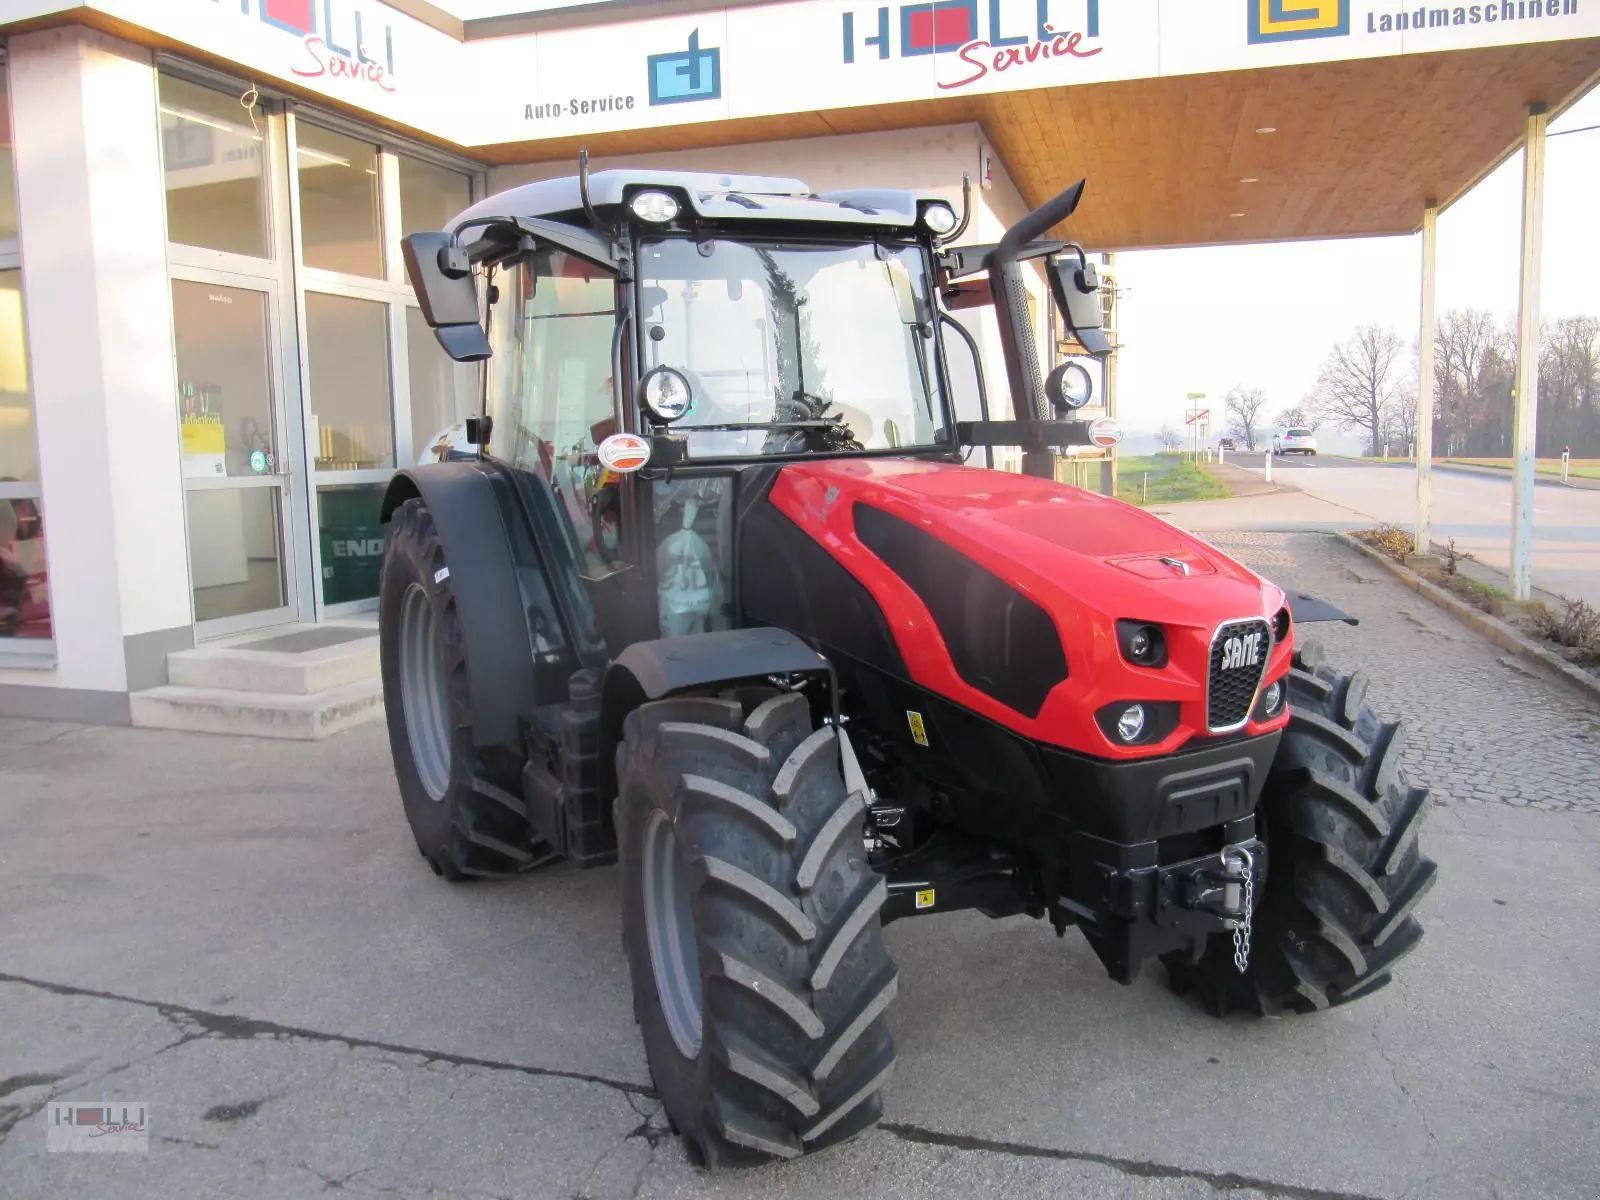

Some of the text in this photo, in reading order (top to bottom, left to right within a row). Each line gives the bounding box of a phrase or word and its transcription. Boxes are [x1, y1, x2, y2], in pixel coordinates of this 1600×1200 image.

[1366, 0, 1578, 33] Landmaschinen
[290, 37, 396, 92] Service
[936, 24, 1104, 90] Service
[524, 95, 635, 120] Auto-Service
[1221, 632, 1261, 671] SAME
